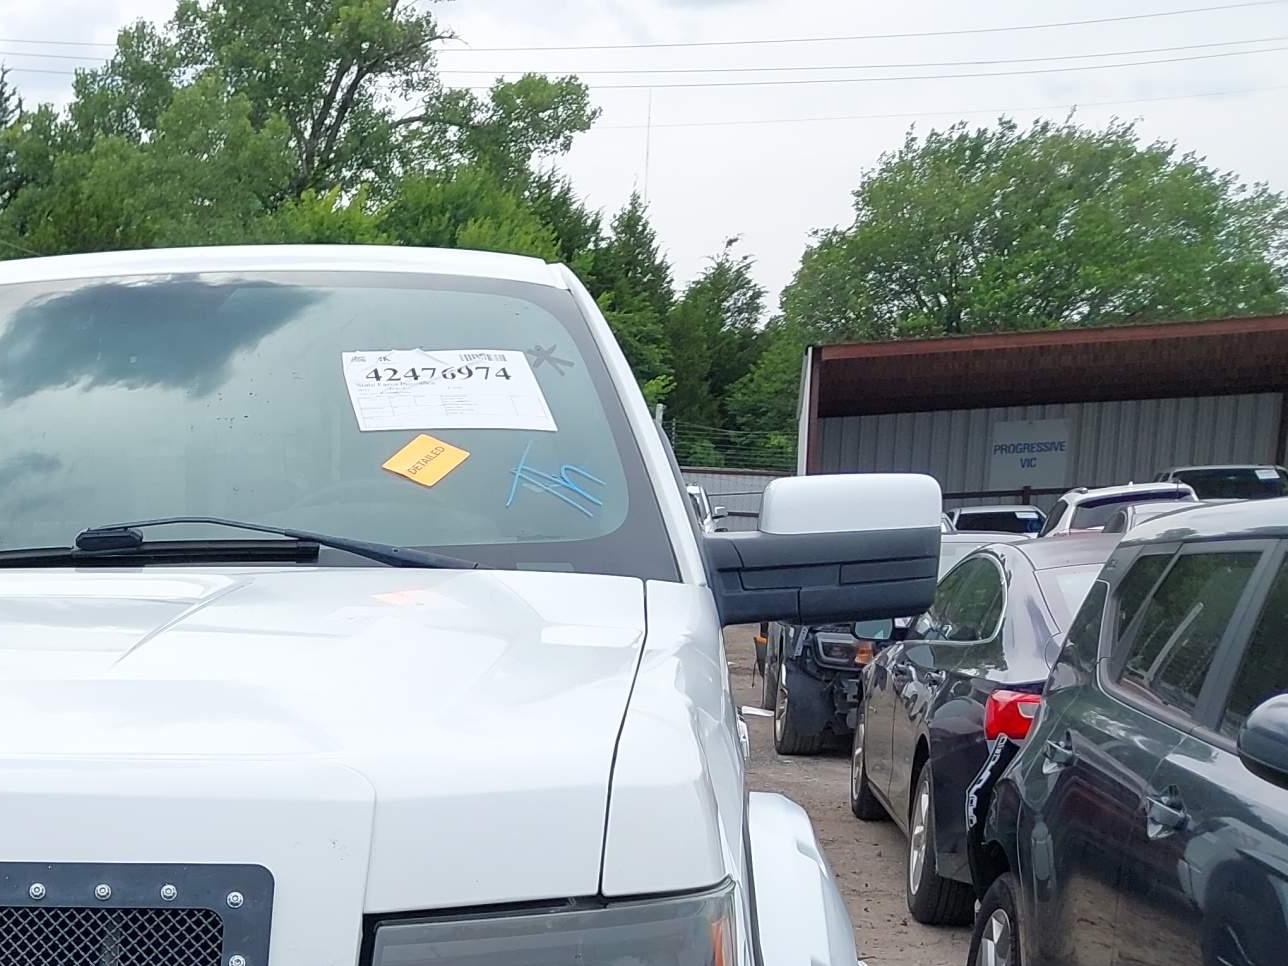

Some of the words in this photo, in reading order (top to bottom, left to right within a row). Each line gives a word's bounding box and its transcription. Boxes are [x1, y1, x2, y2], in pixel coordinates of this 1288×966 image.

[365, 366, 512, 381] 42476974
[993, 441, 1066, 455] PROGRESSIVE
[407, 446, 445, 475] DETAILED
[1020, 457, 1037, 468] VIC
